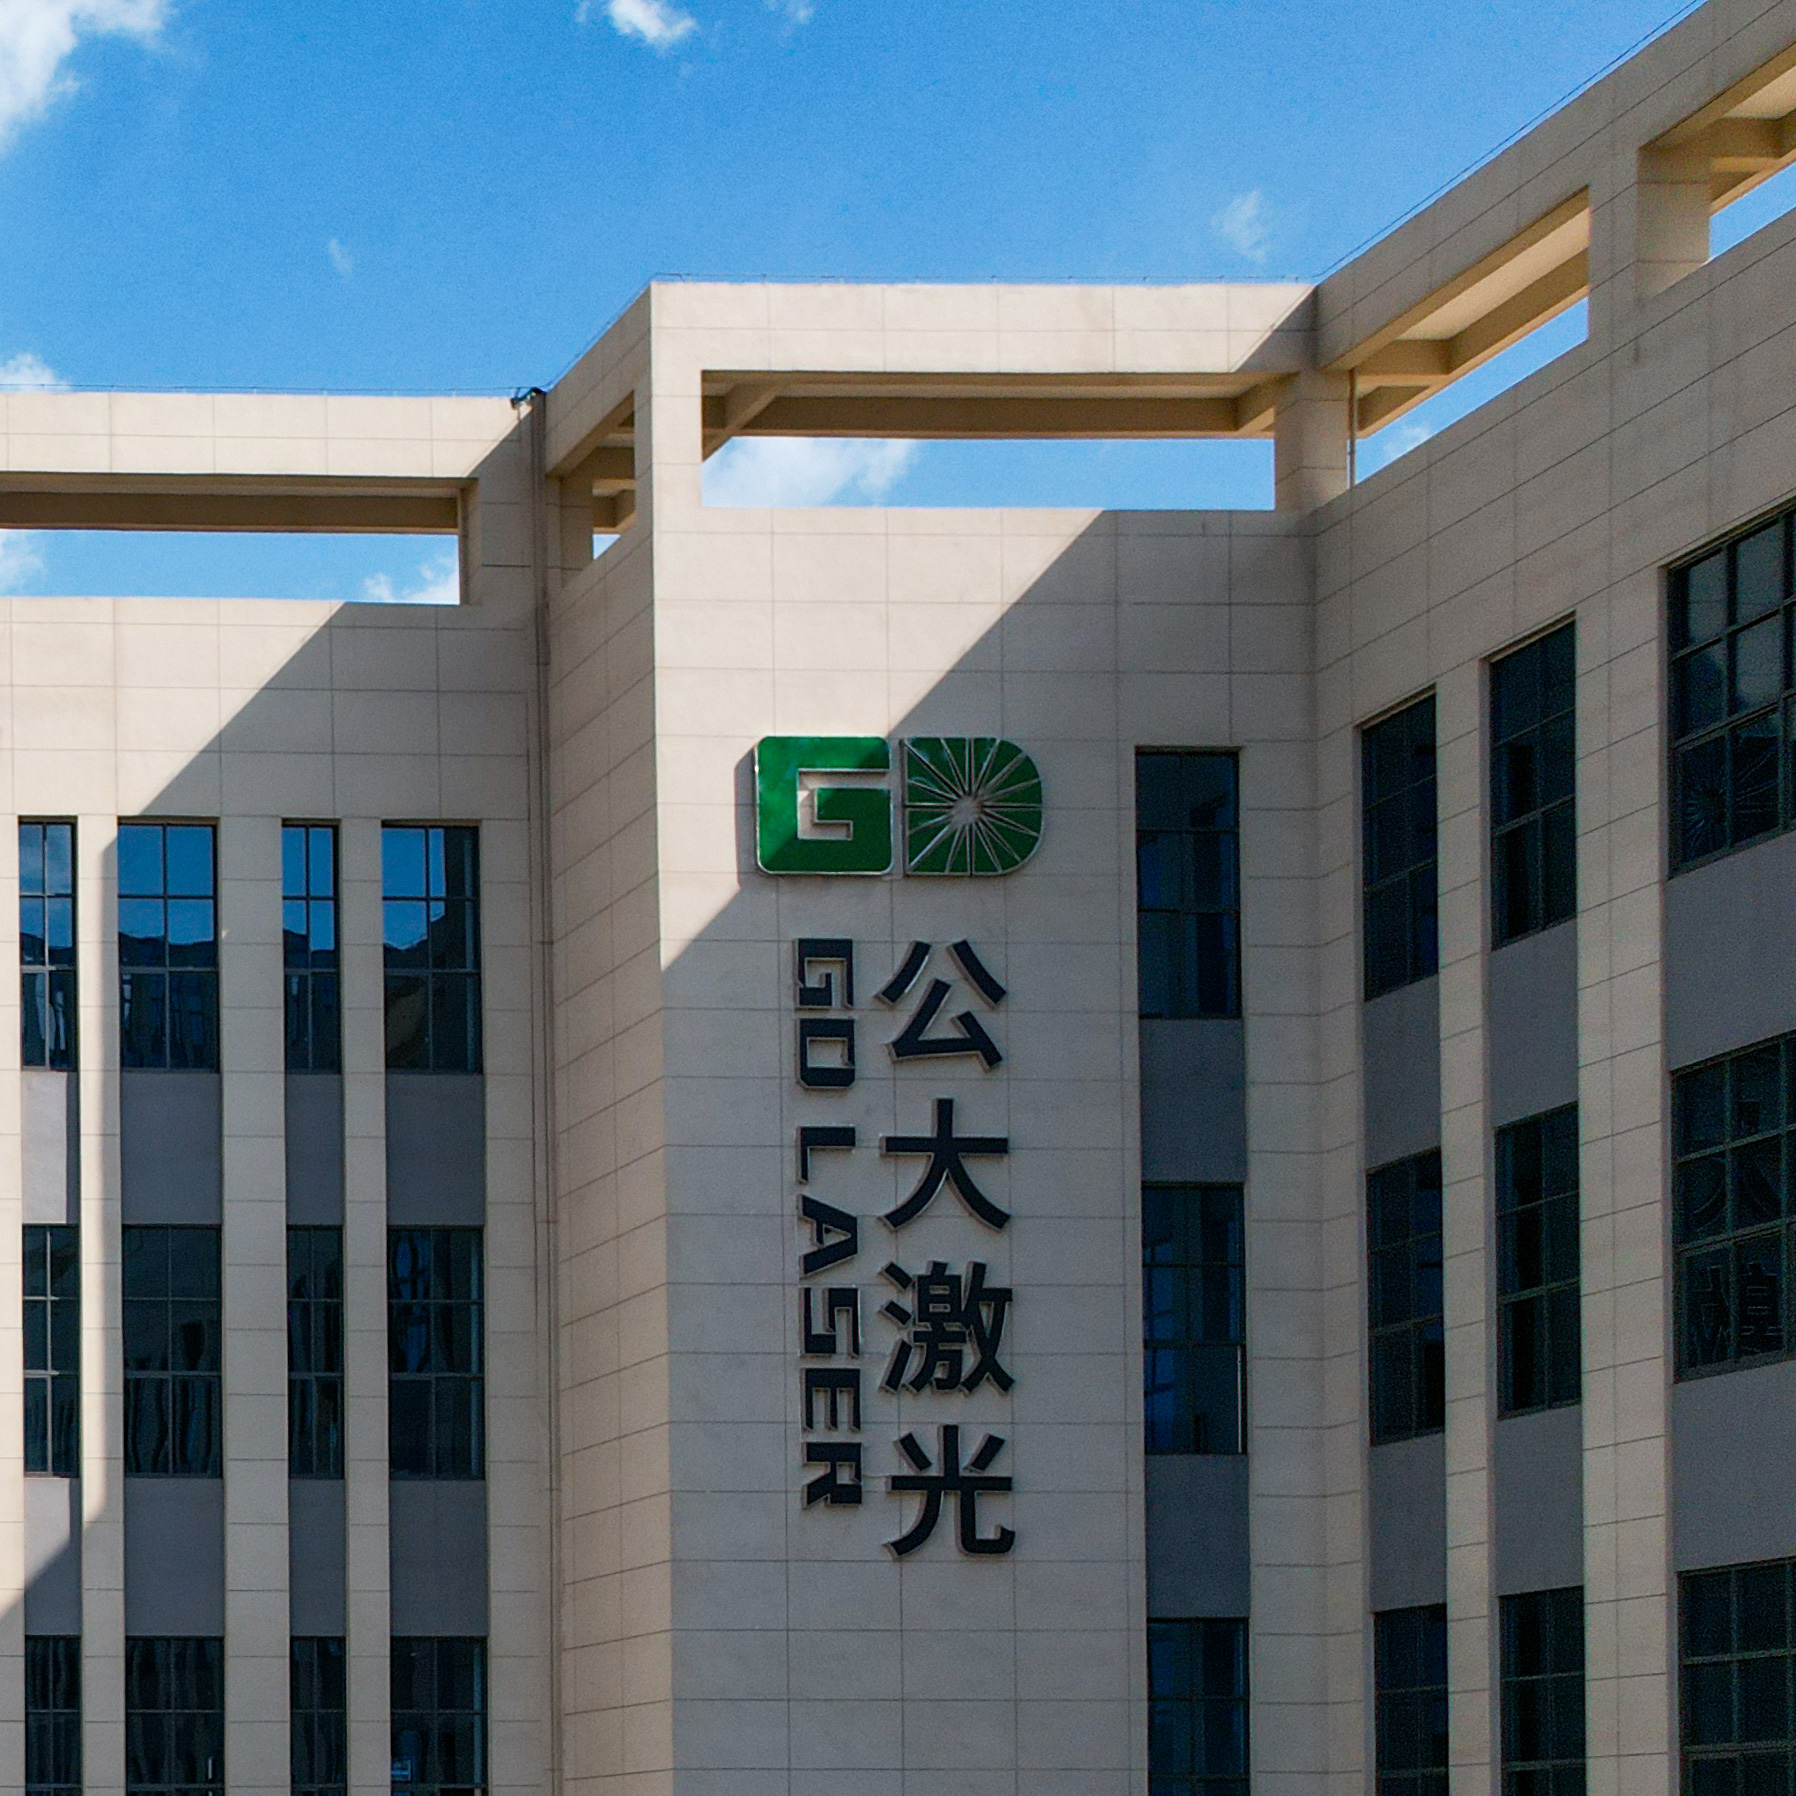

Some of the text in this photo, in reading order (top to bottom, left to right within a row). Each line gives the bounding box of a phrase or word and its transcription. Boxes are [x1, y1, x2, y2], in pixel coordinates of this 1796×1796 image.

[795, 938, 863, 1509] GD LASER
[878, 939, 1017, 1559] 公大激光
